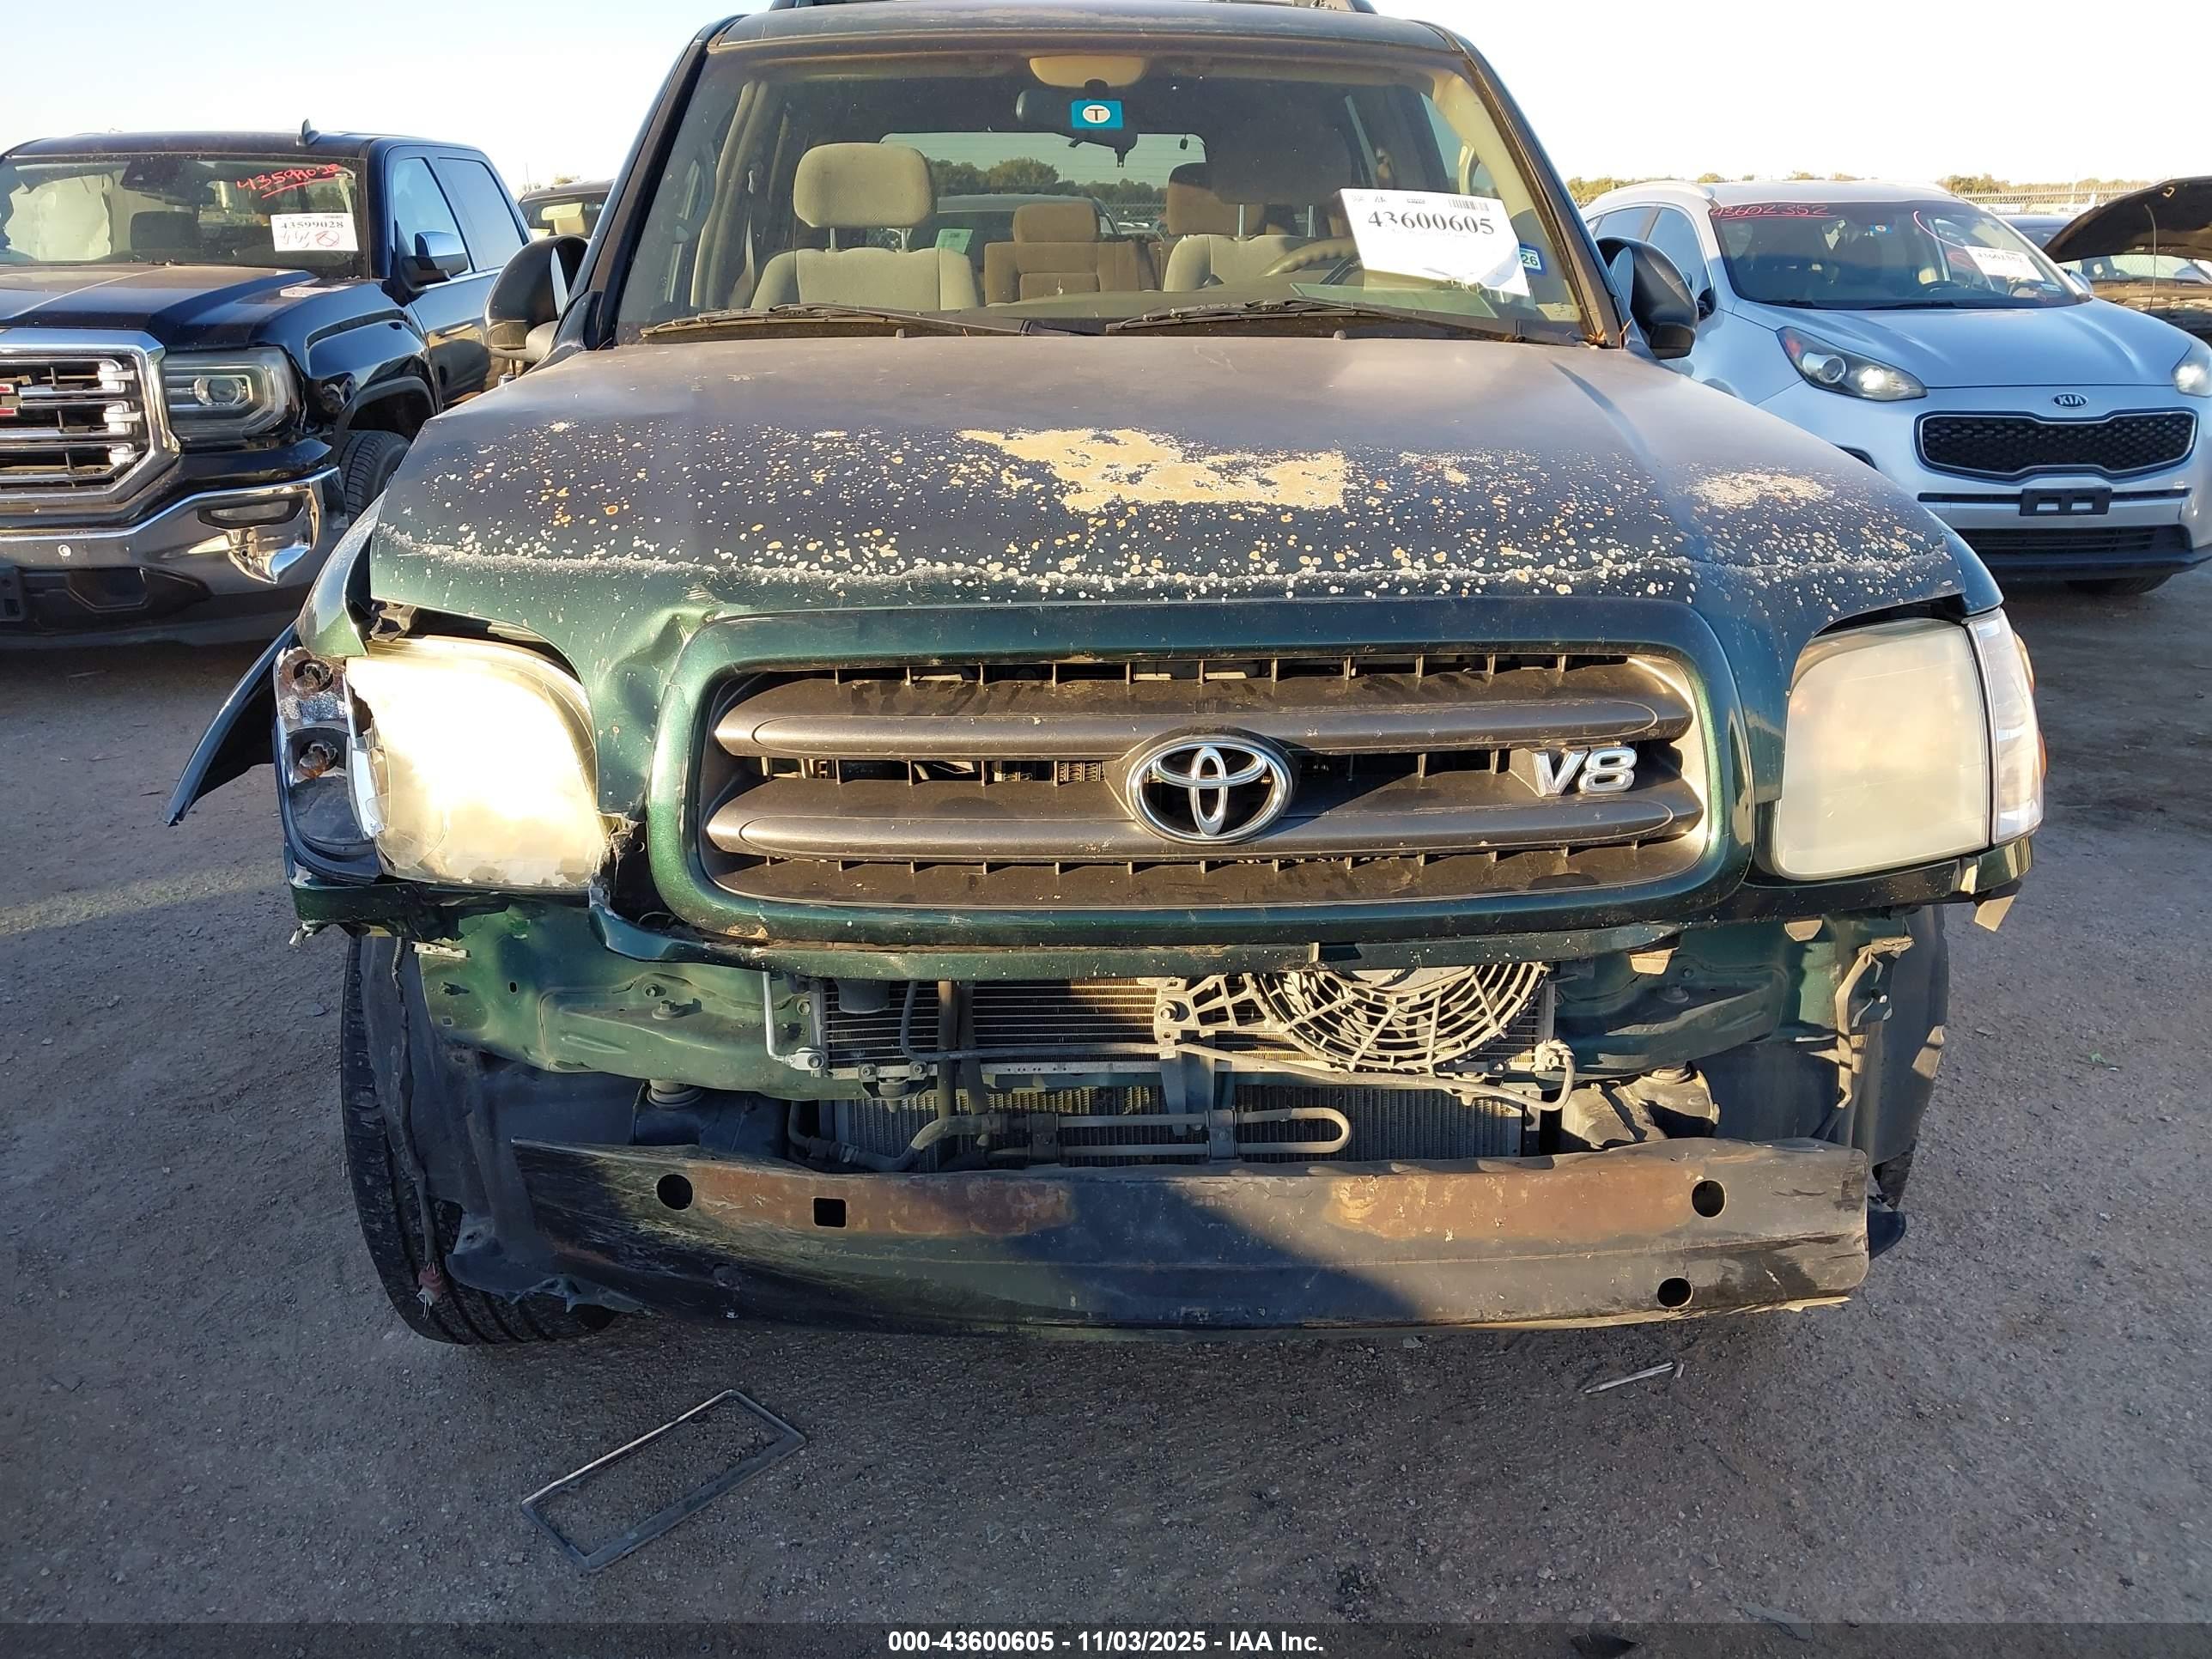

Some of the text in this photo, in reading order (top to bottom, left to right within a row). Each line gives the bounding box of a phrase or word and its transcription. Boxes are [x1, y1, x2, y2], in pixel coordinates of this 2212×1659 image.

[1088, 108, 1104, 121] T
[280, 220, 344, 229] 43599028
[1368, 210, 1495, 235] 43600605
[1520, 253, 1539, 266] 26
[2058, 395, 2084, 405] KIA
[1531, 746, 1638, 797] V8
